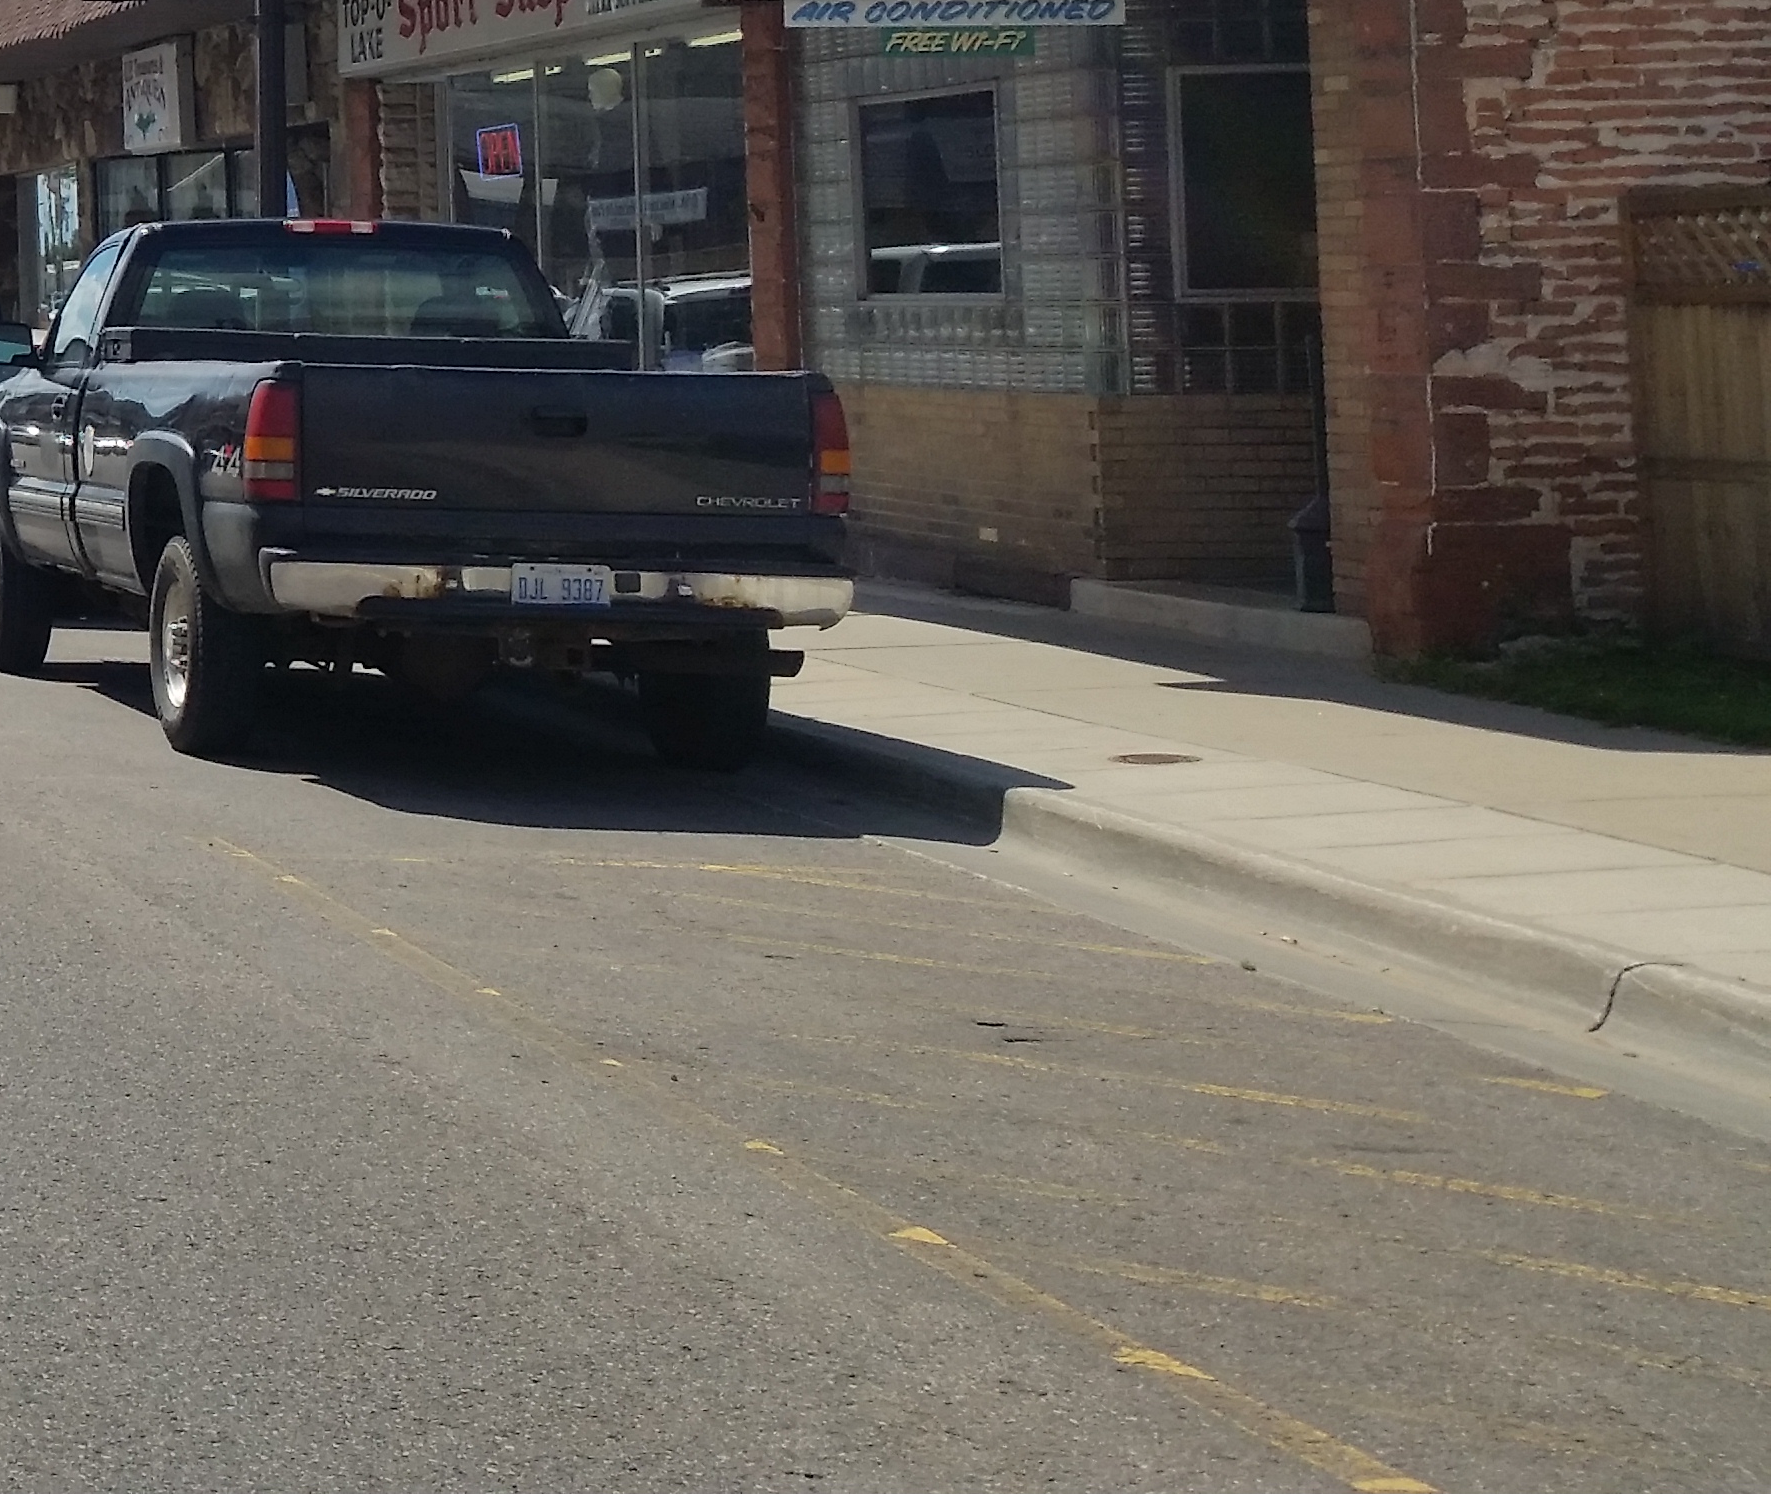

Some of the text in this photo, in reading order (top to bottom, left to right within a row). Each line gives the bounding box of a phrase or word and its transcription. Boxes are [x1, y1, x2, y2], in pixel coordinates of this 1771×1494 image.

[792, 0, 855, 22] AIR
[351, 28, 384, 63] LAKE
[885, 31, 949, 53] FREE
[480, 130, 520, 174] OPEN
[336, 486, 438, 501] SILVERADO
[696, 495, 802, 508] CHEVROLET
[518, 577, 604, 602] DJL 9387
